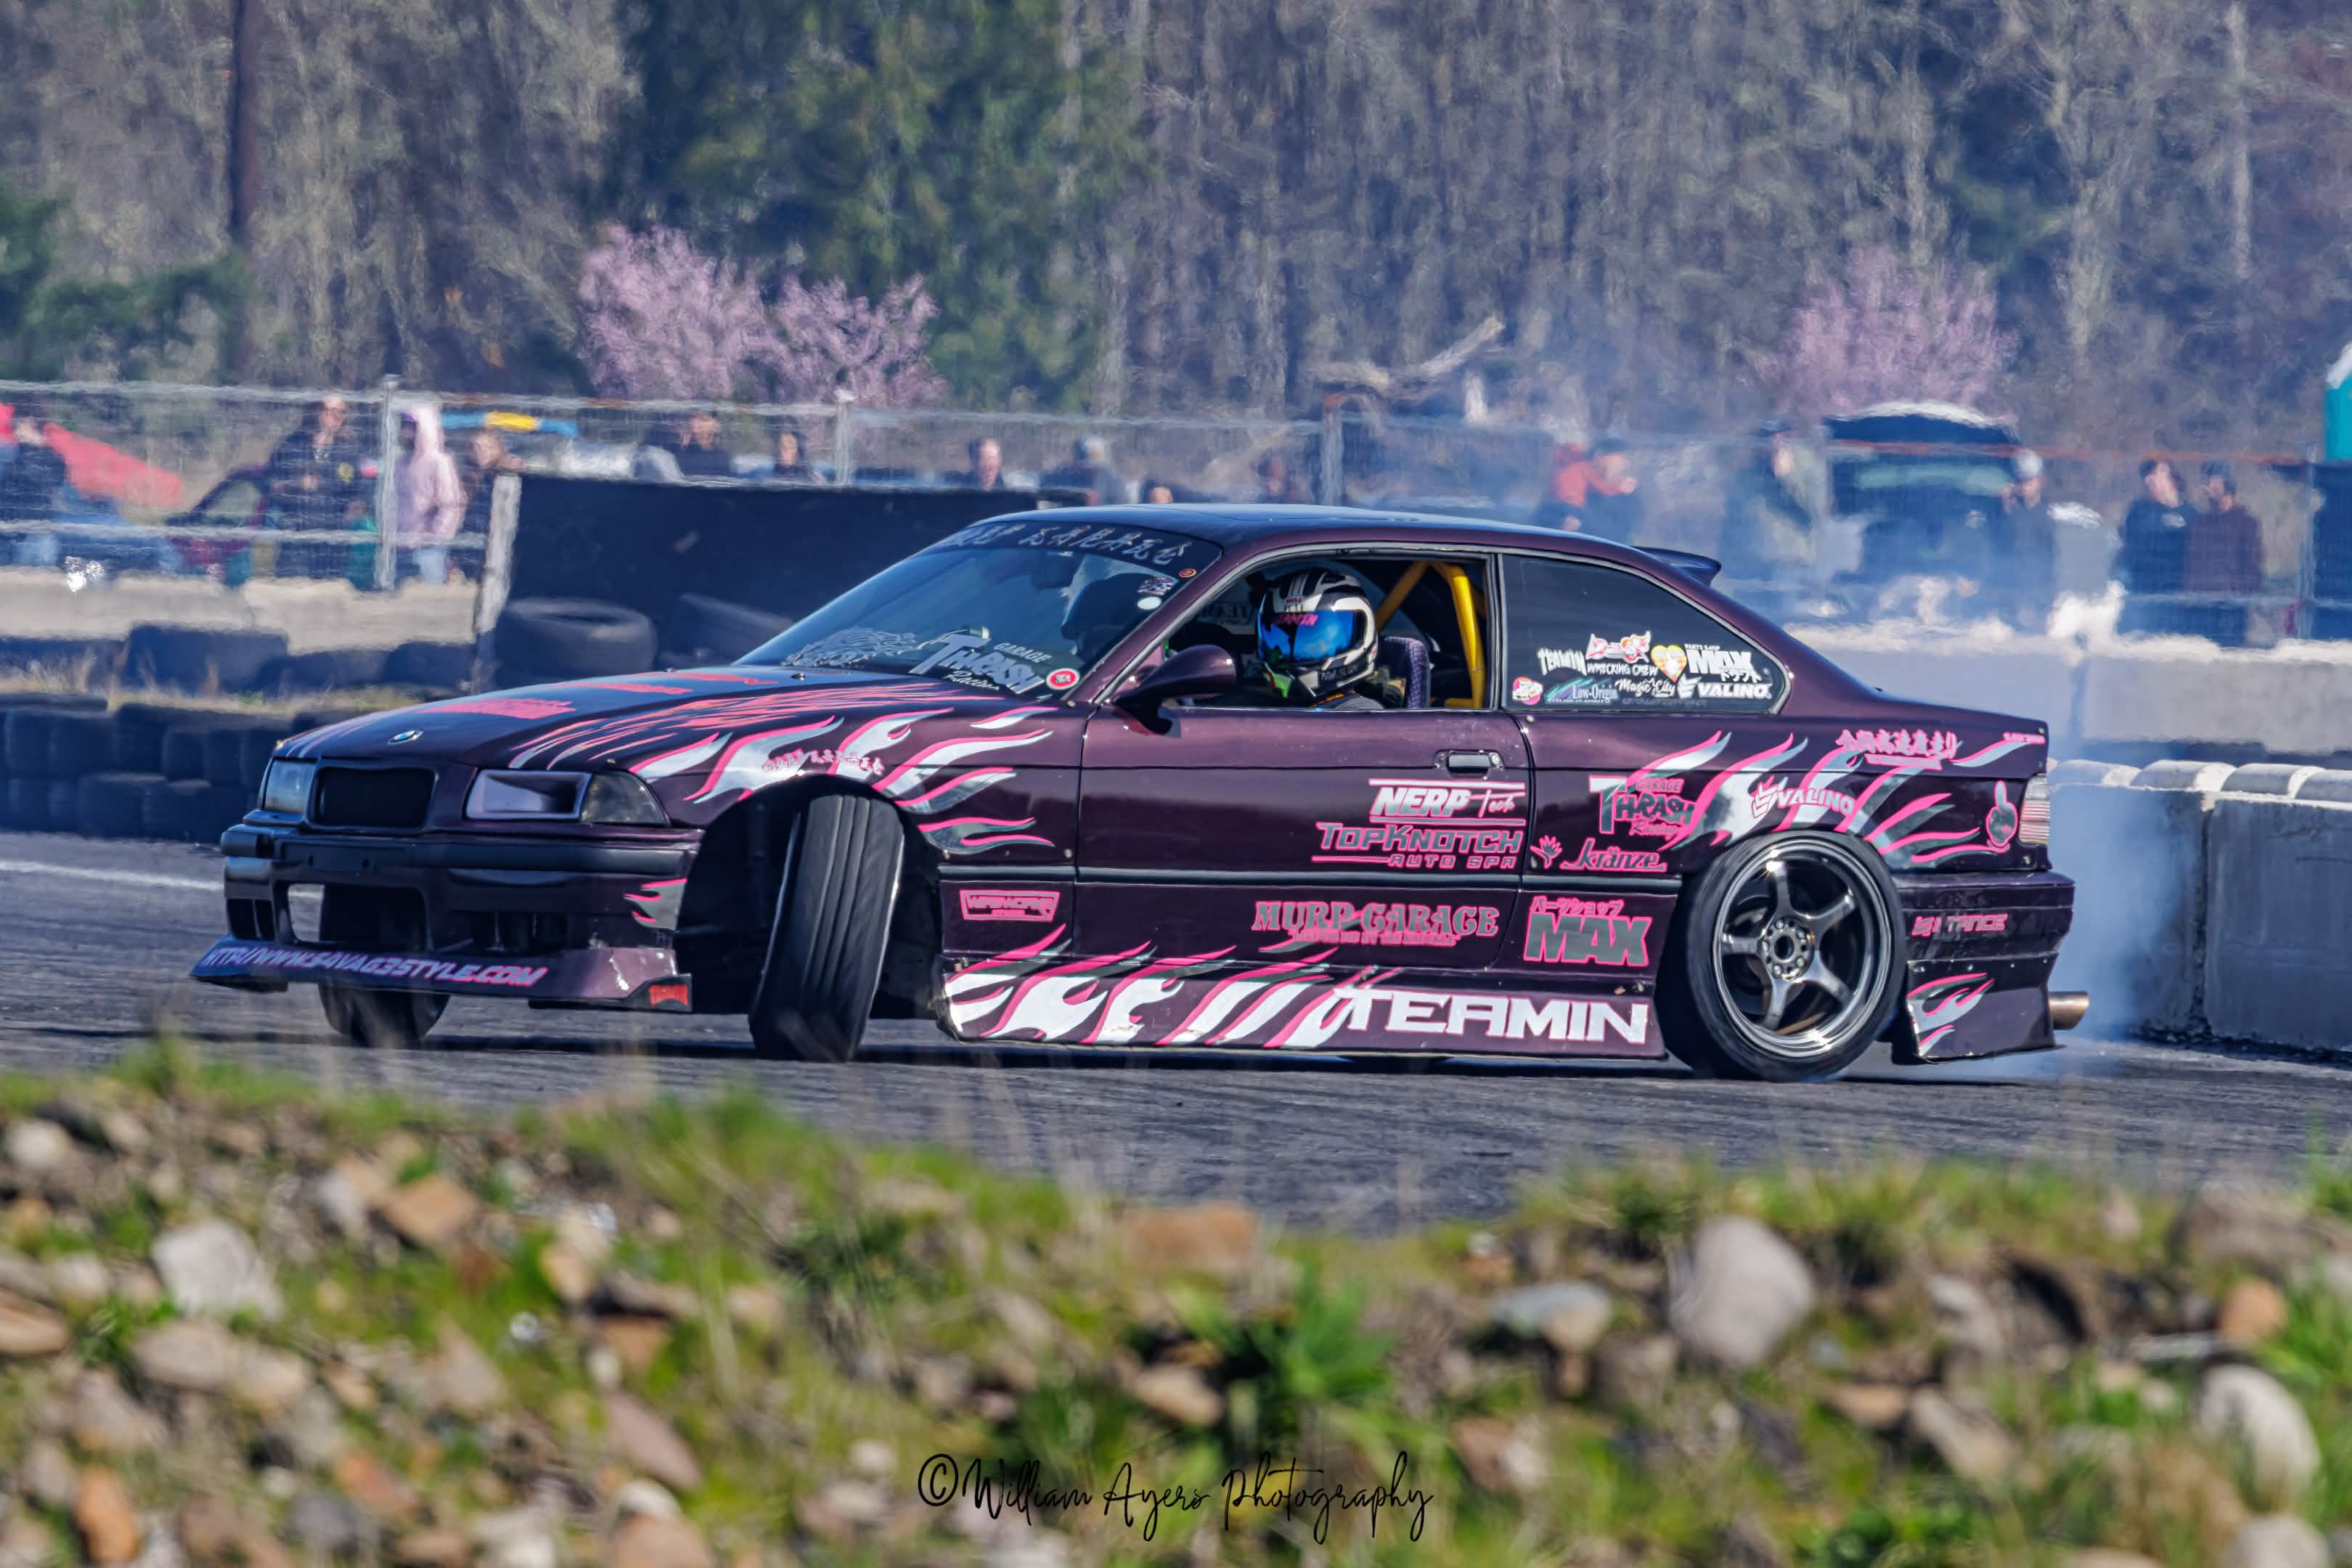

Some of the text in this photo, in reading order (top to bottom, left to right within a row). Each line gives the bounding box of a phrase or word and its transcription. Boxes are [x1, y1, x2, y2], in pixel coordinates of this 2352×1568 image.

[994, 642, 1052, 663] GARAGE
[1685, 649, 1753, 674] MAX
[1587, 662, 1659, 677] WRECKING CREW
[1572, 685, 1620, 701] Low-Origin
[1697, 682, 1772, 699] VALINO
[1636, 778, 1684, 793] GARAGE
[1370, 785, 1472, 817] NERP
[1589, 775, 1696, 835] THRASH
[1778, 788, 1855, 816] VALINO
[1387, 854, 1517, 870] AUTO SPA
[1361, 902, 1500, 936] GARAGE
[1523, 912, 1653, 967] MAX
[1334, 987, 1649, 1045] TEAMIN
